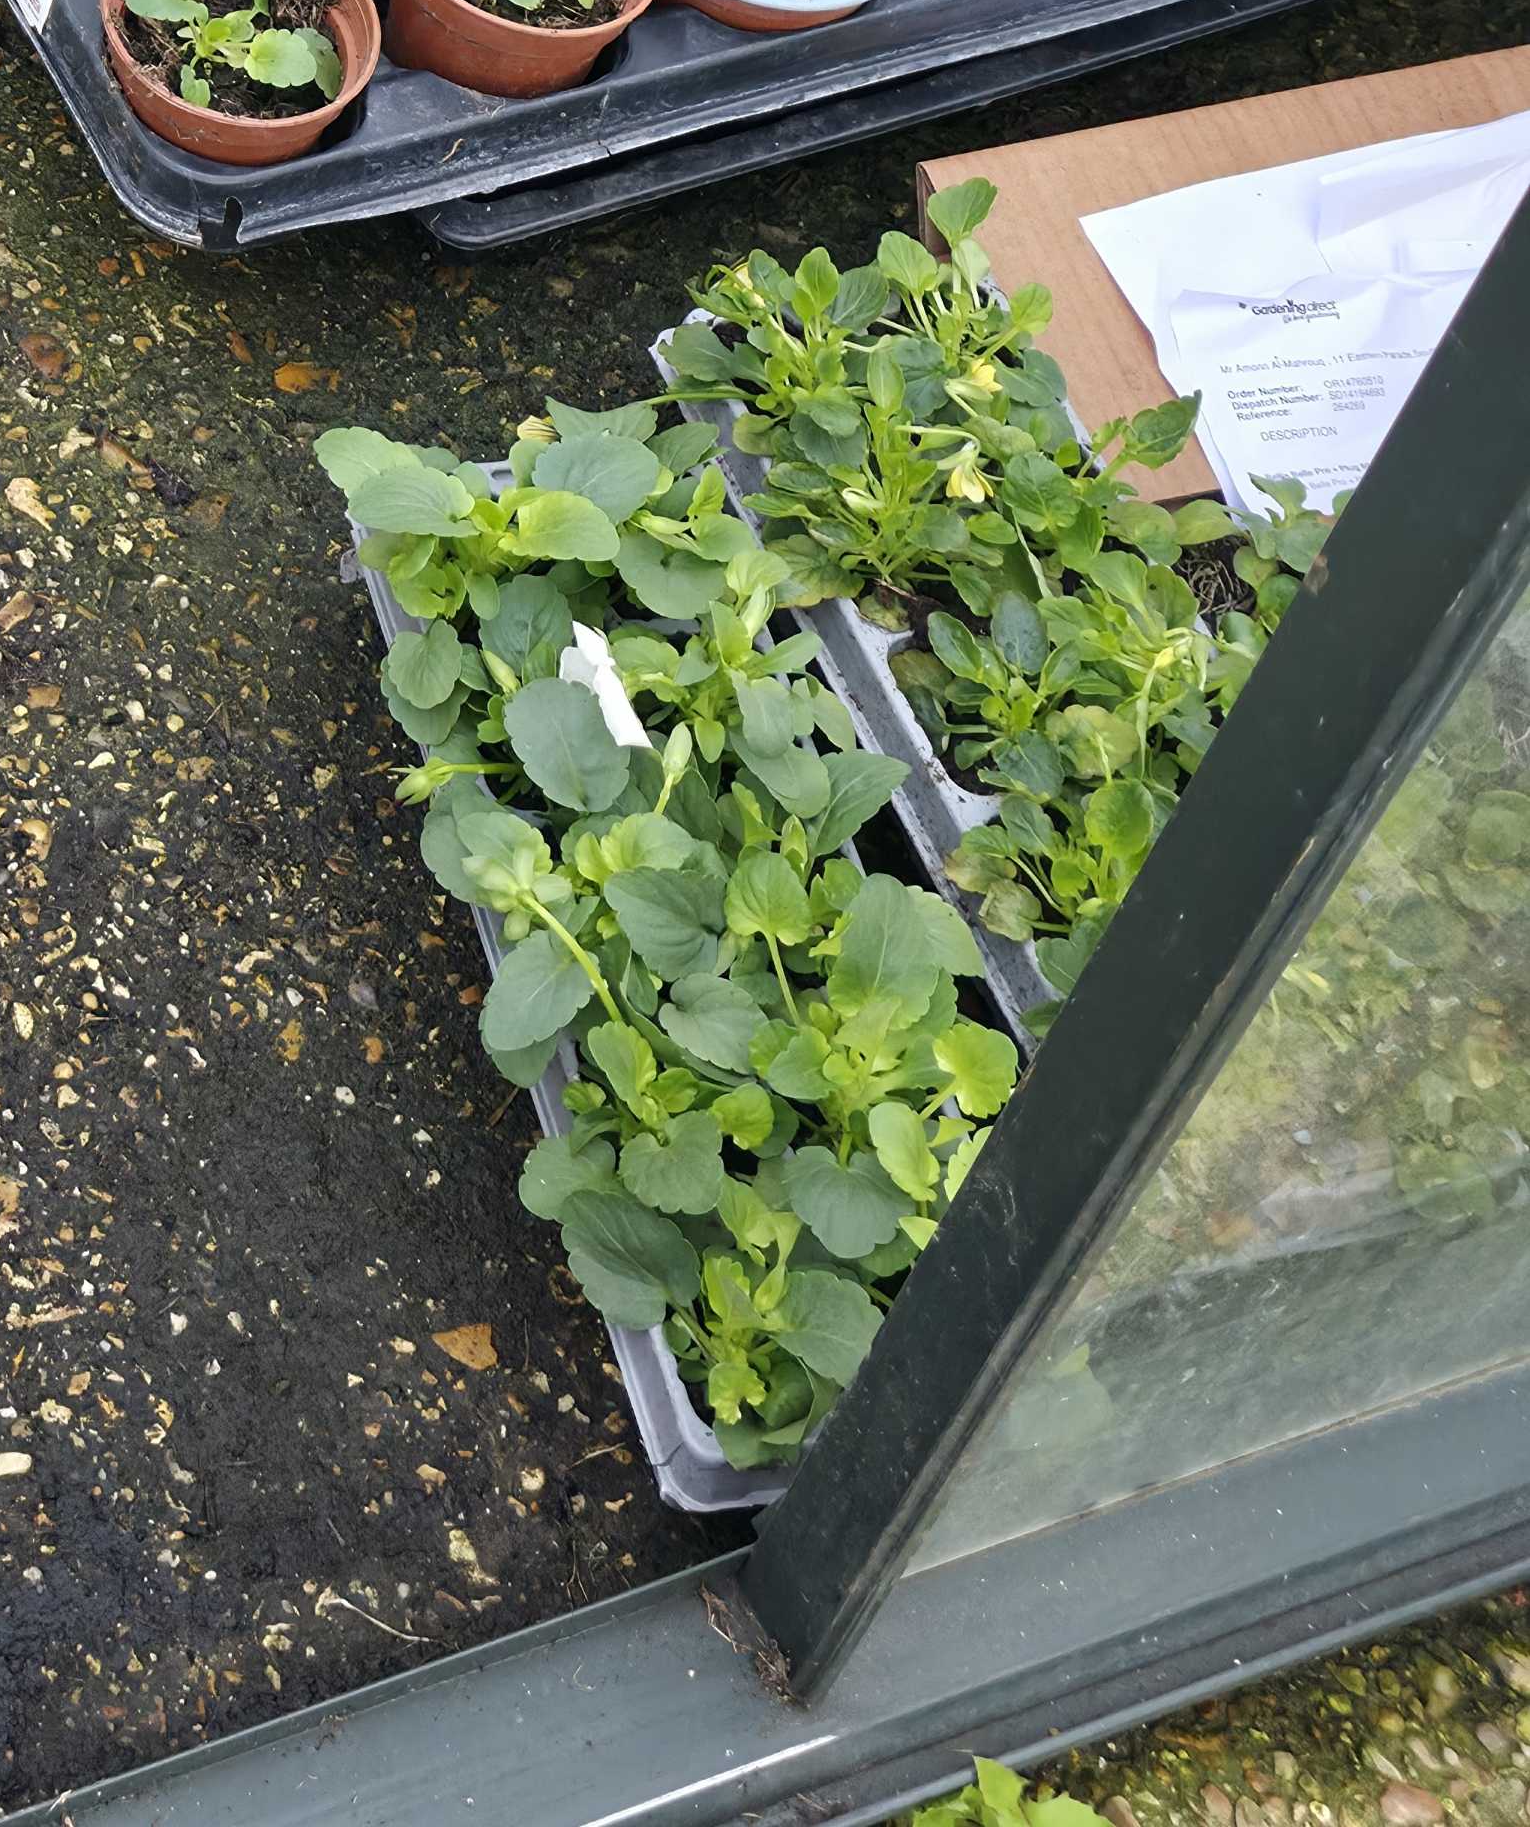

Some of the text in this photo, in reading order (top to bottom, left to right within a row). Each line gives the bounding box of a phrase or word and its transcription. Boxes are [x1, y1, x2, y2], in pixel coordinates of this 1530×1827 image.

[1251, 300, 1306, 315] Gardening
[1227, 390, 1256, 401] Order
[1259, 384, 1303, 397] Number:
[1231, 398, 1279, 412] Dispatch
[1281, 393, 1324, 406] Number:
[1236, 408, 1293, 422] Reference:
[1260, 426, 1338, 442] DESCRIPTION
